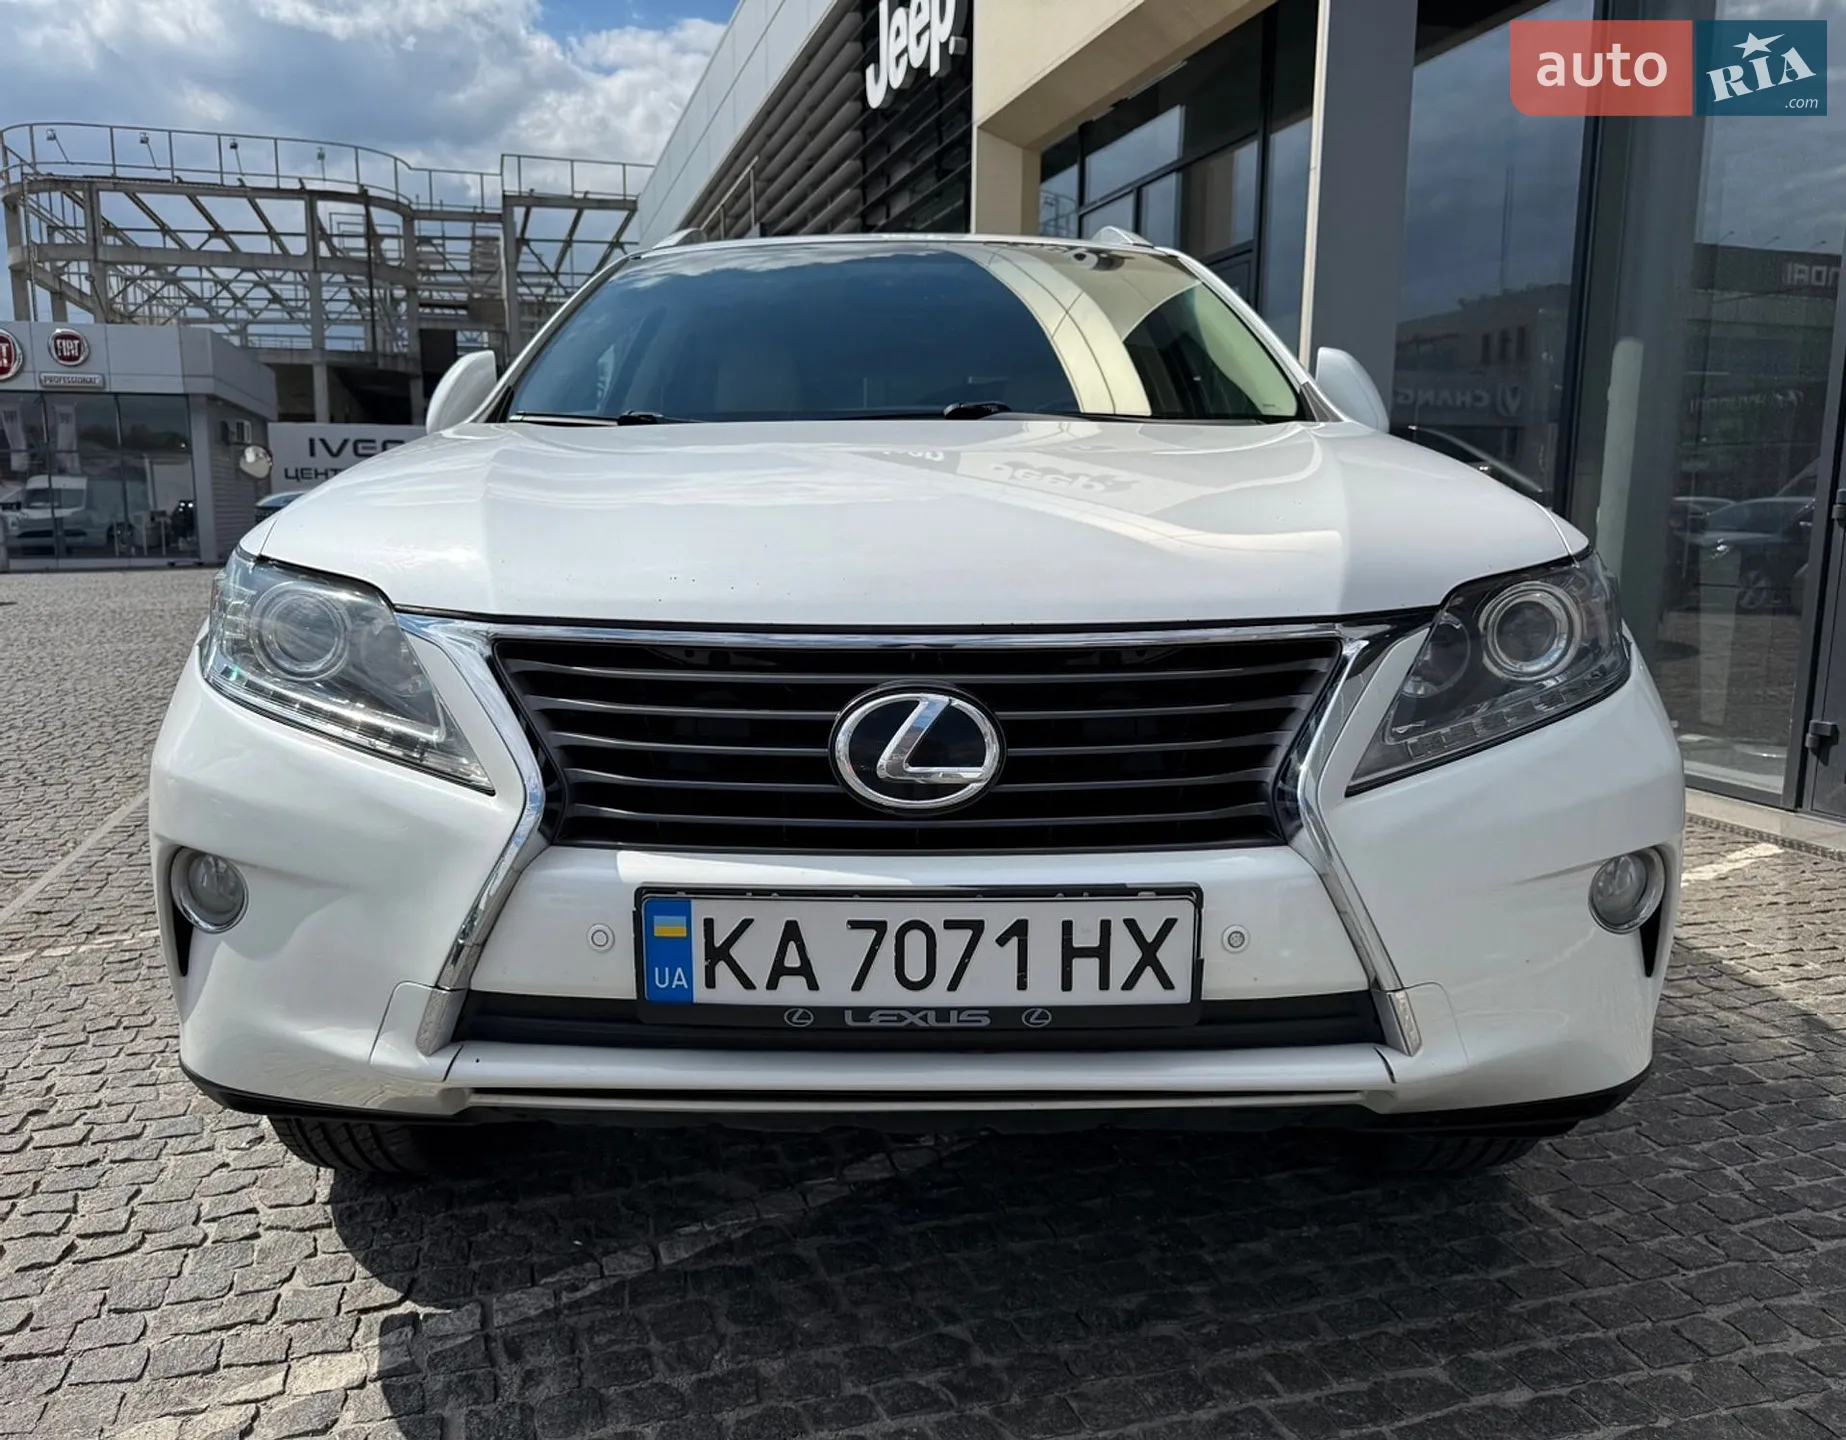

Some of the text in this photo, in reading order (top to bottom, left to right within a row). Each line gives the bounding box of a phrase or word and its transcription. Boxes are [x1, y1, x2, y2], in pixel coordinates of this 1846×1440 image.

[56, 339, 80, 356] FIAT
[702, 917, 1179, 993] KA 7071 HX
[655, 967, 689, 989] UA
[844, 1009, 991, 1027] LEXUS
